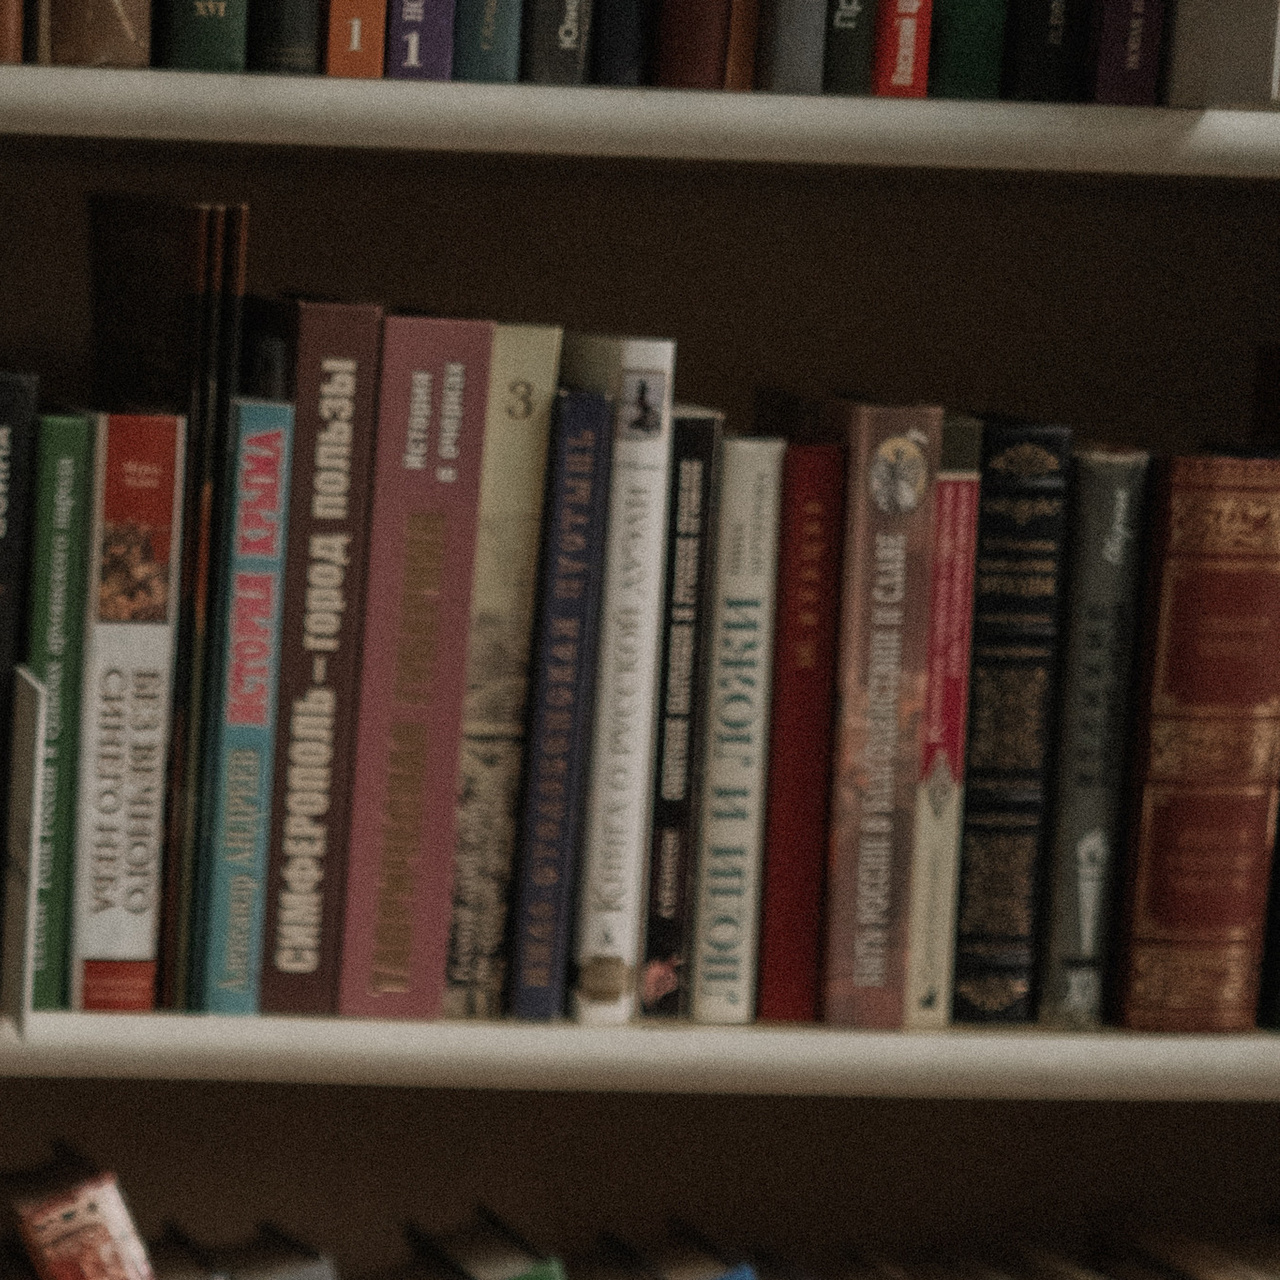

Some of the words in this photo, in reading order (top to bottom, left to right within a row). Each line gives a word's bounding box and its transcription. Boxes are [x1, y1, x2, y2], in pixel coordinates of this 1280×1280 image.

[347, 17, 362, 52] 1
[402, 32, 422, 67] 1
[400, 371, 433, 471] История
[437, 360, 468, 460] очерках
[507, 381, 534, 422] 3
[236, 429, 282, 558] КРЫМА
[553, 430, 596, 599] ПУСТЫНЬ
[132, 670, 162, 735] БЕЗ
[225, 571, 277, 727] ИСТОРИЯ
[712, 597, 761, 767] ЛОЖИ
[96, 667, 126, 815] СИНЕГО
[123, 745, 159, 915] ВЕЧНОГО
[223, 748, 266, 868] АНДРЕЕВ
[274, 688, 337, 974] СИМФЕРОПОЛЬ
[707, 787, 750, 819] И
[90, 825, 119, 915] НЕБА
[698, 846, 746, 1004] ЛЮДИ
